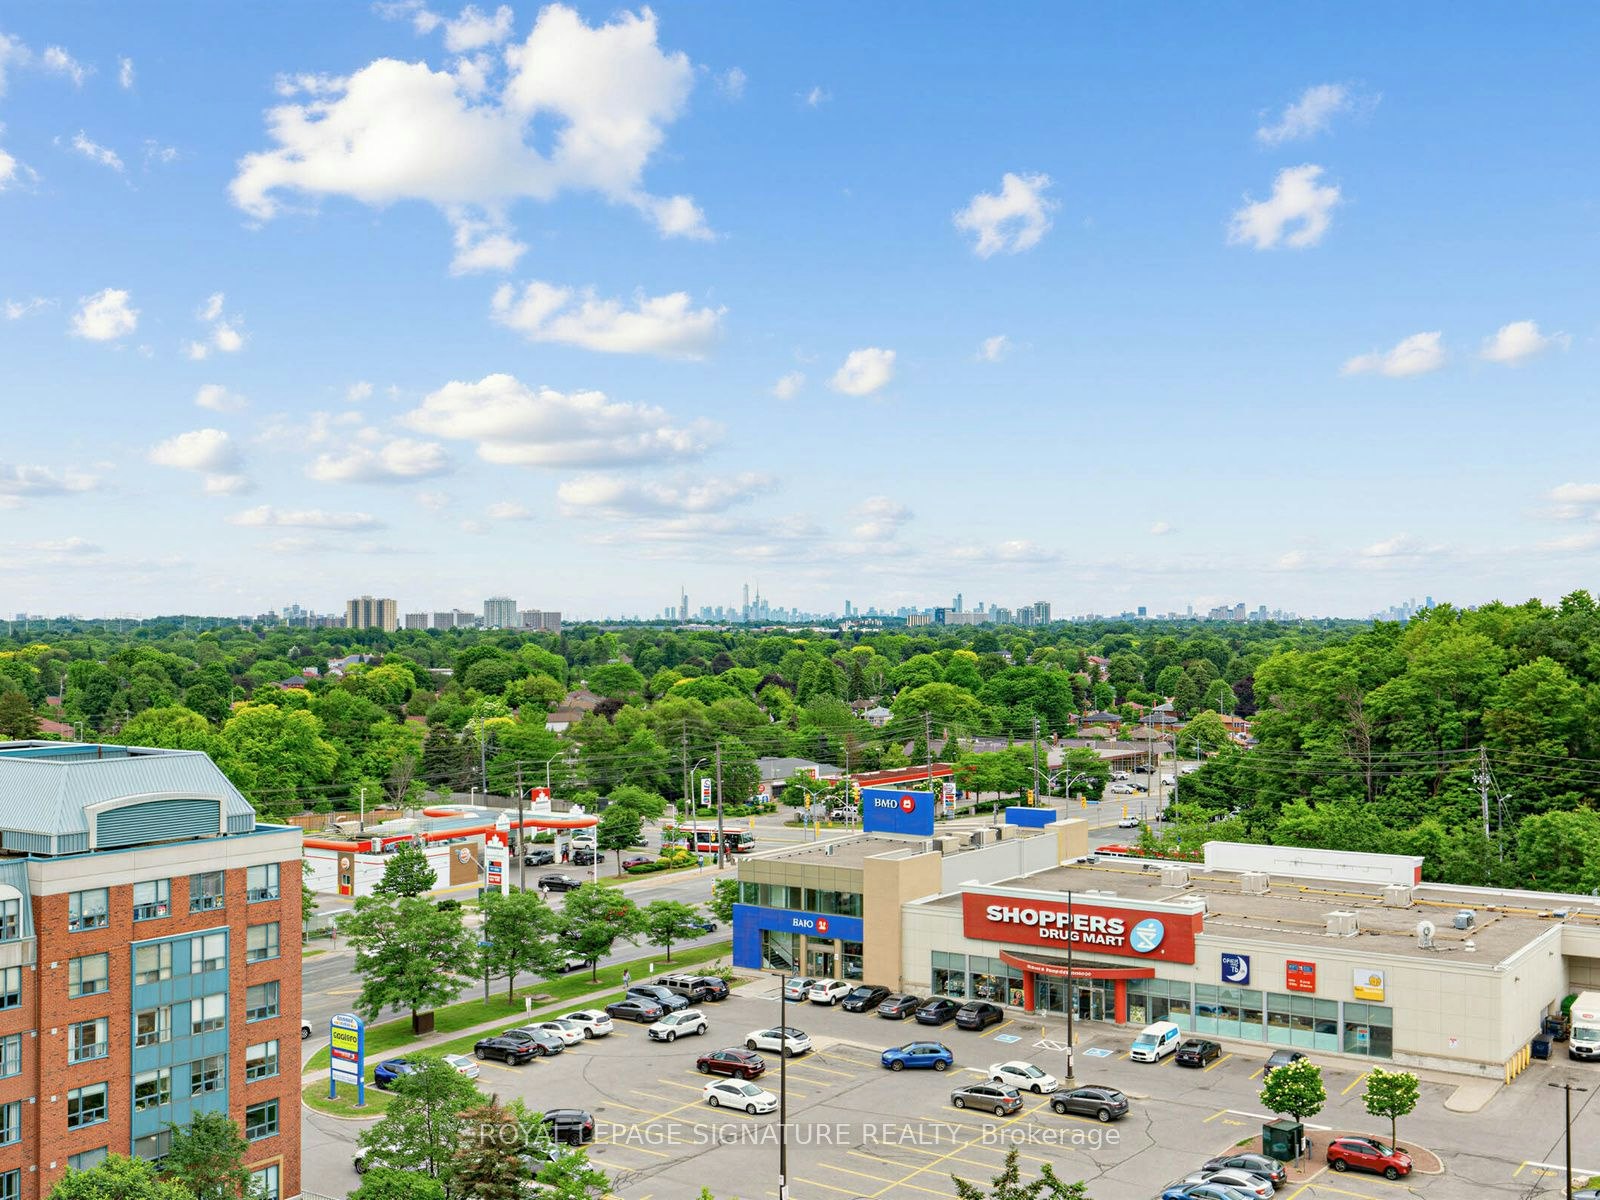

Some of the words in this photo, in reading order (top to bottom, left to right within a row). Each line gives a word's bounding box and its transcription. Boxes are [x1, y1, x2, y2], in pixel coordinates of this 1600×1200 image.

[874, 798, 898, 809] BMO
[986, 905, 1125, 935] SHOPPERS
[1039, 927, 1080, 942] DRUG
[1082, 933, 1125, 946] MART
